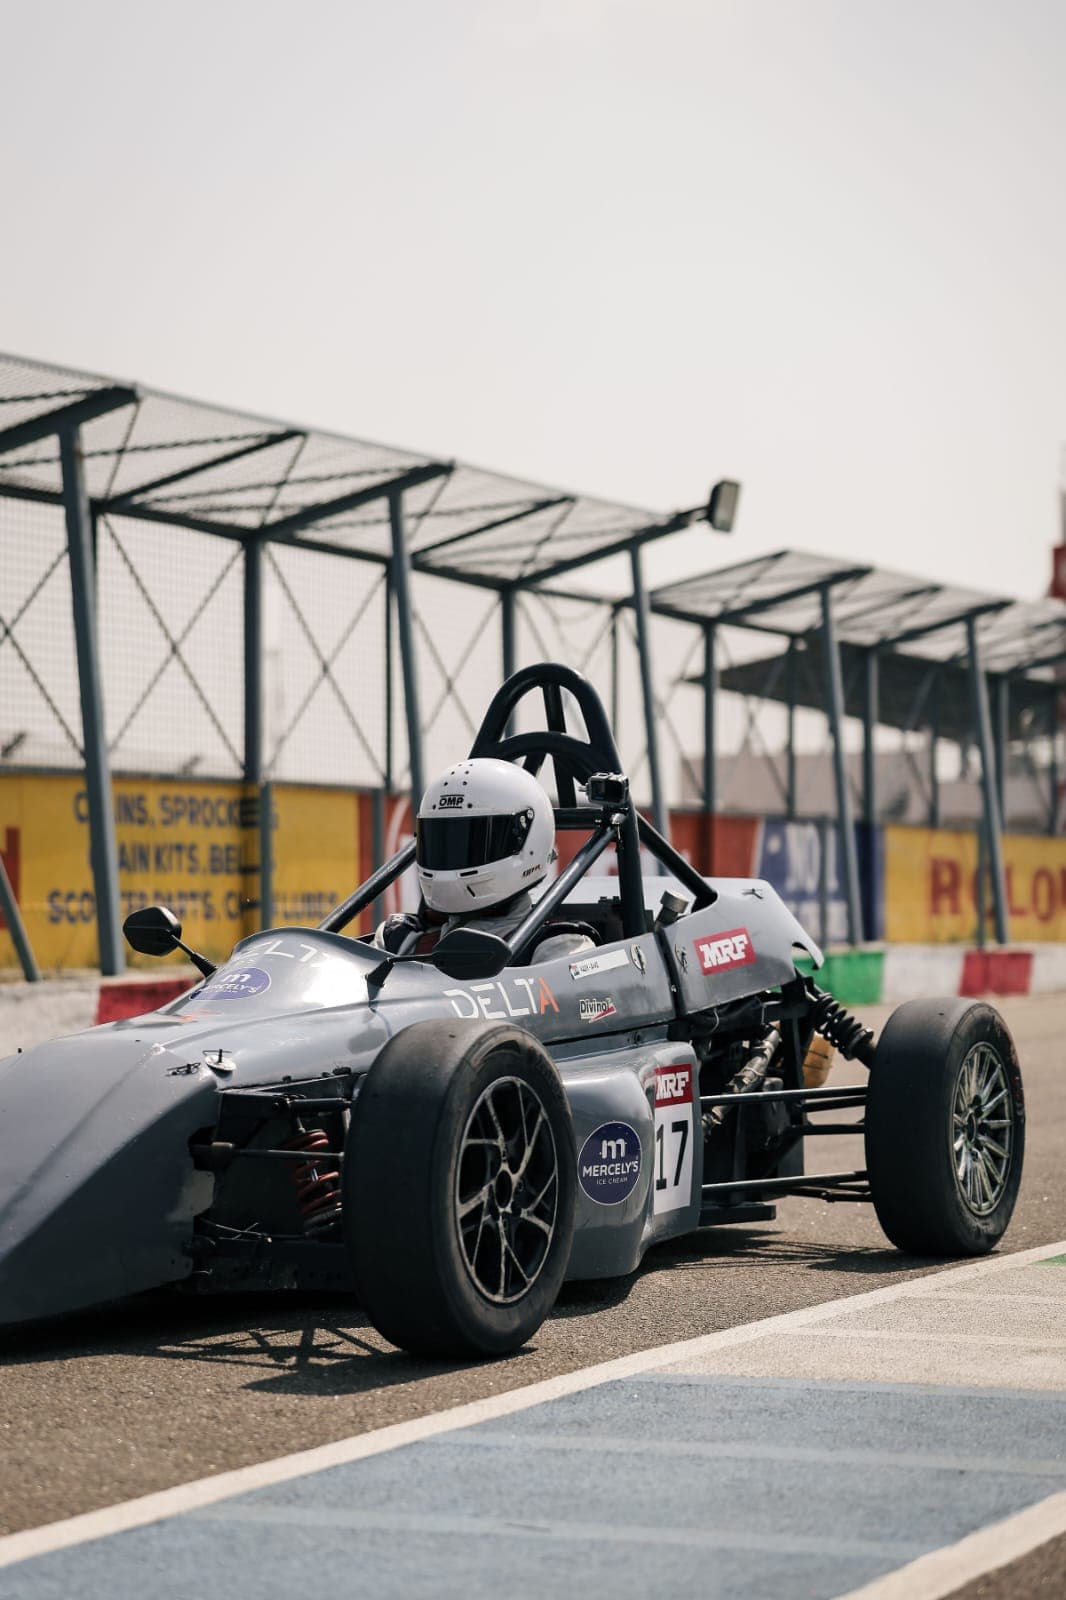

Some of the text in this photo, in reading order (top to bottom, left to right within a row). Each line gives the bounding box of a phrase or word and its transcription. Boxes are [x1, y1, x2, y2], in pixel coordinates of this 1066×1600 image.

[438, 796, 465, 807] OMP
[699, 933, 749, 969] MRF
[442, 977, 560, 1019] DELTA
[656, 1071, 689, 1100] MRF
[582, 1160, 639, 1178] MERCELY'S
[656, 1120, 689, 1190] 17
